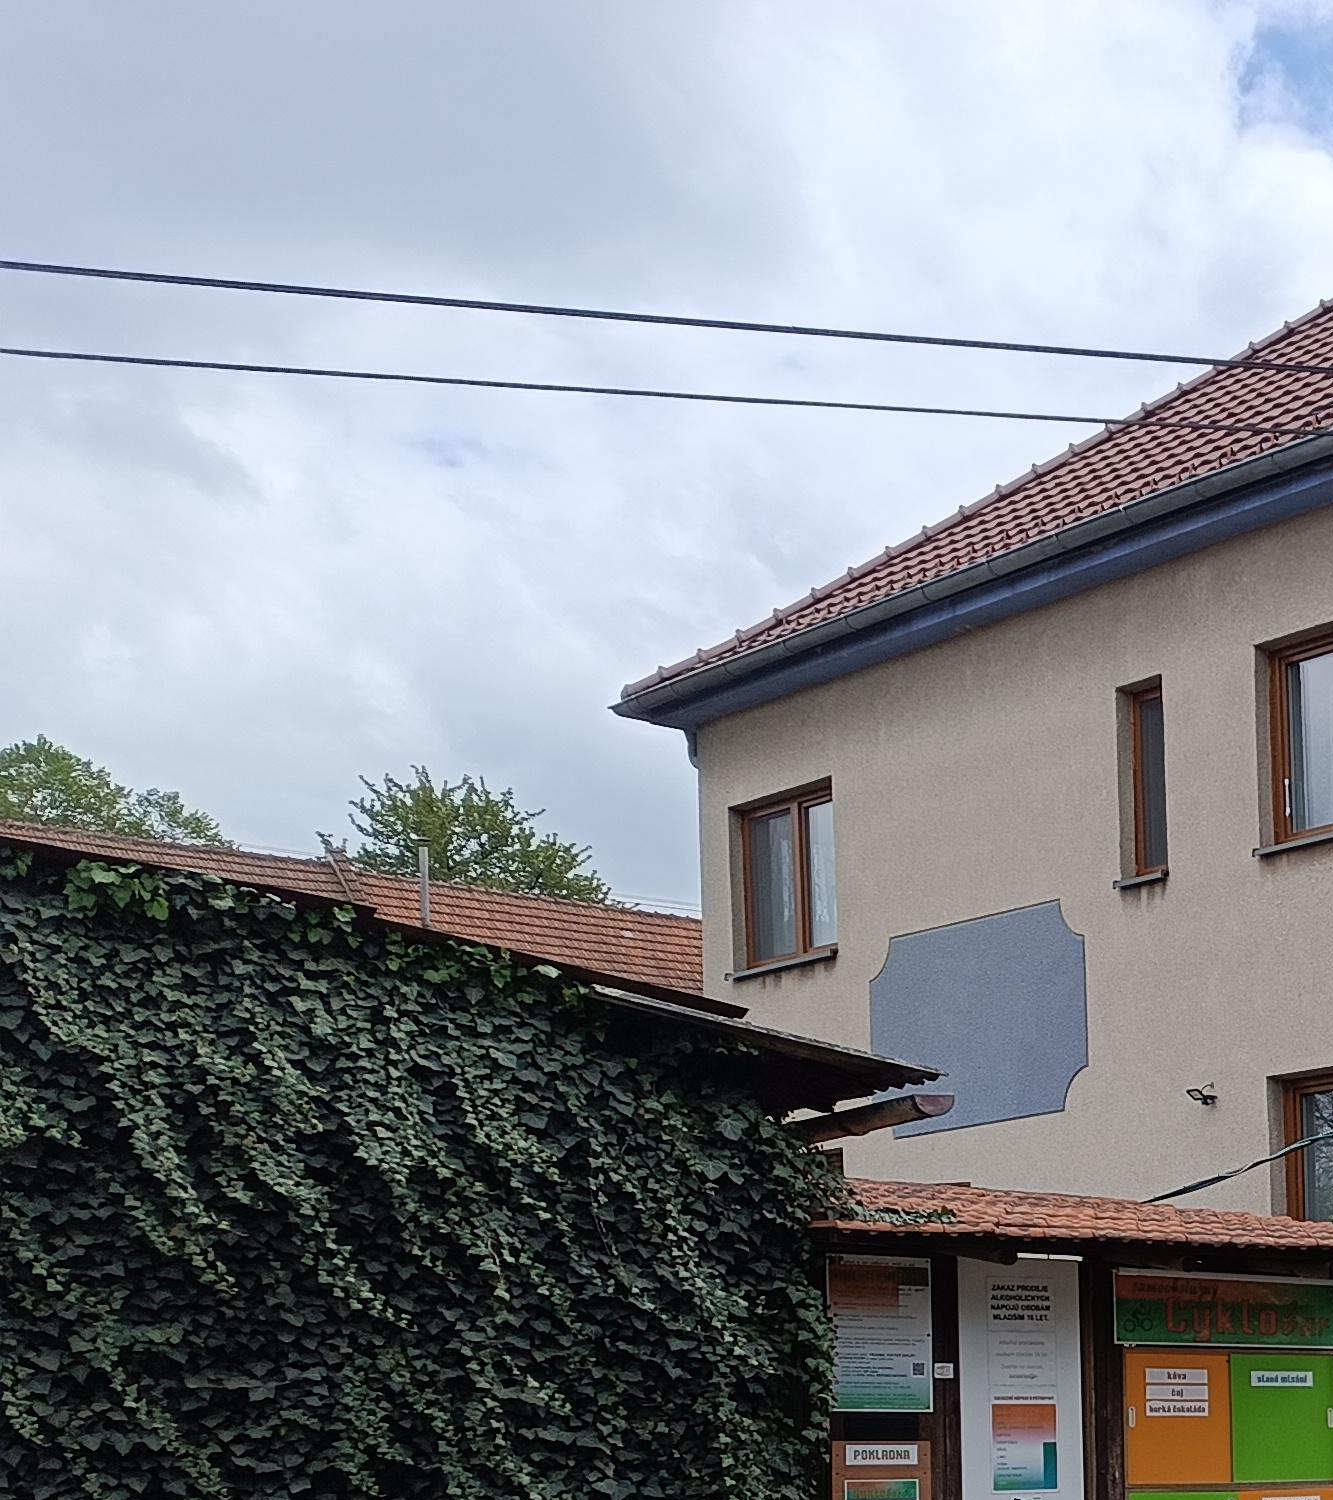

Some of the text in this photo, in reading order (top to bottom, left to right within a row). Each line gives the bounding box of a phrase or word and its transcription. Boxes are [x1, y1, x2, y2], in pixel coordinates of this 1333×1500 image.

[1167, 1370, 1187, 1380] káva
[1171, 1388, 1184, 1398] čaj
[854, 1450, 910, 1460] POKLADNA
